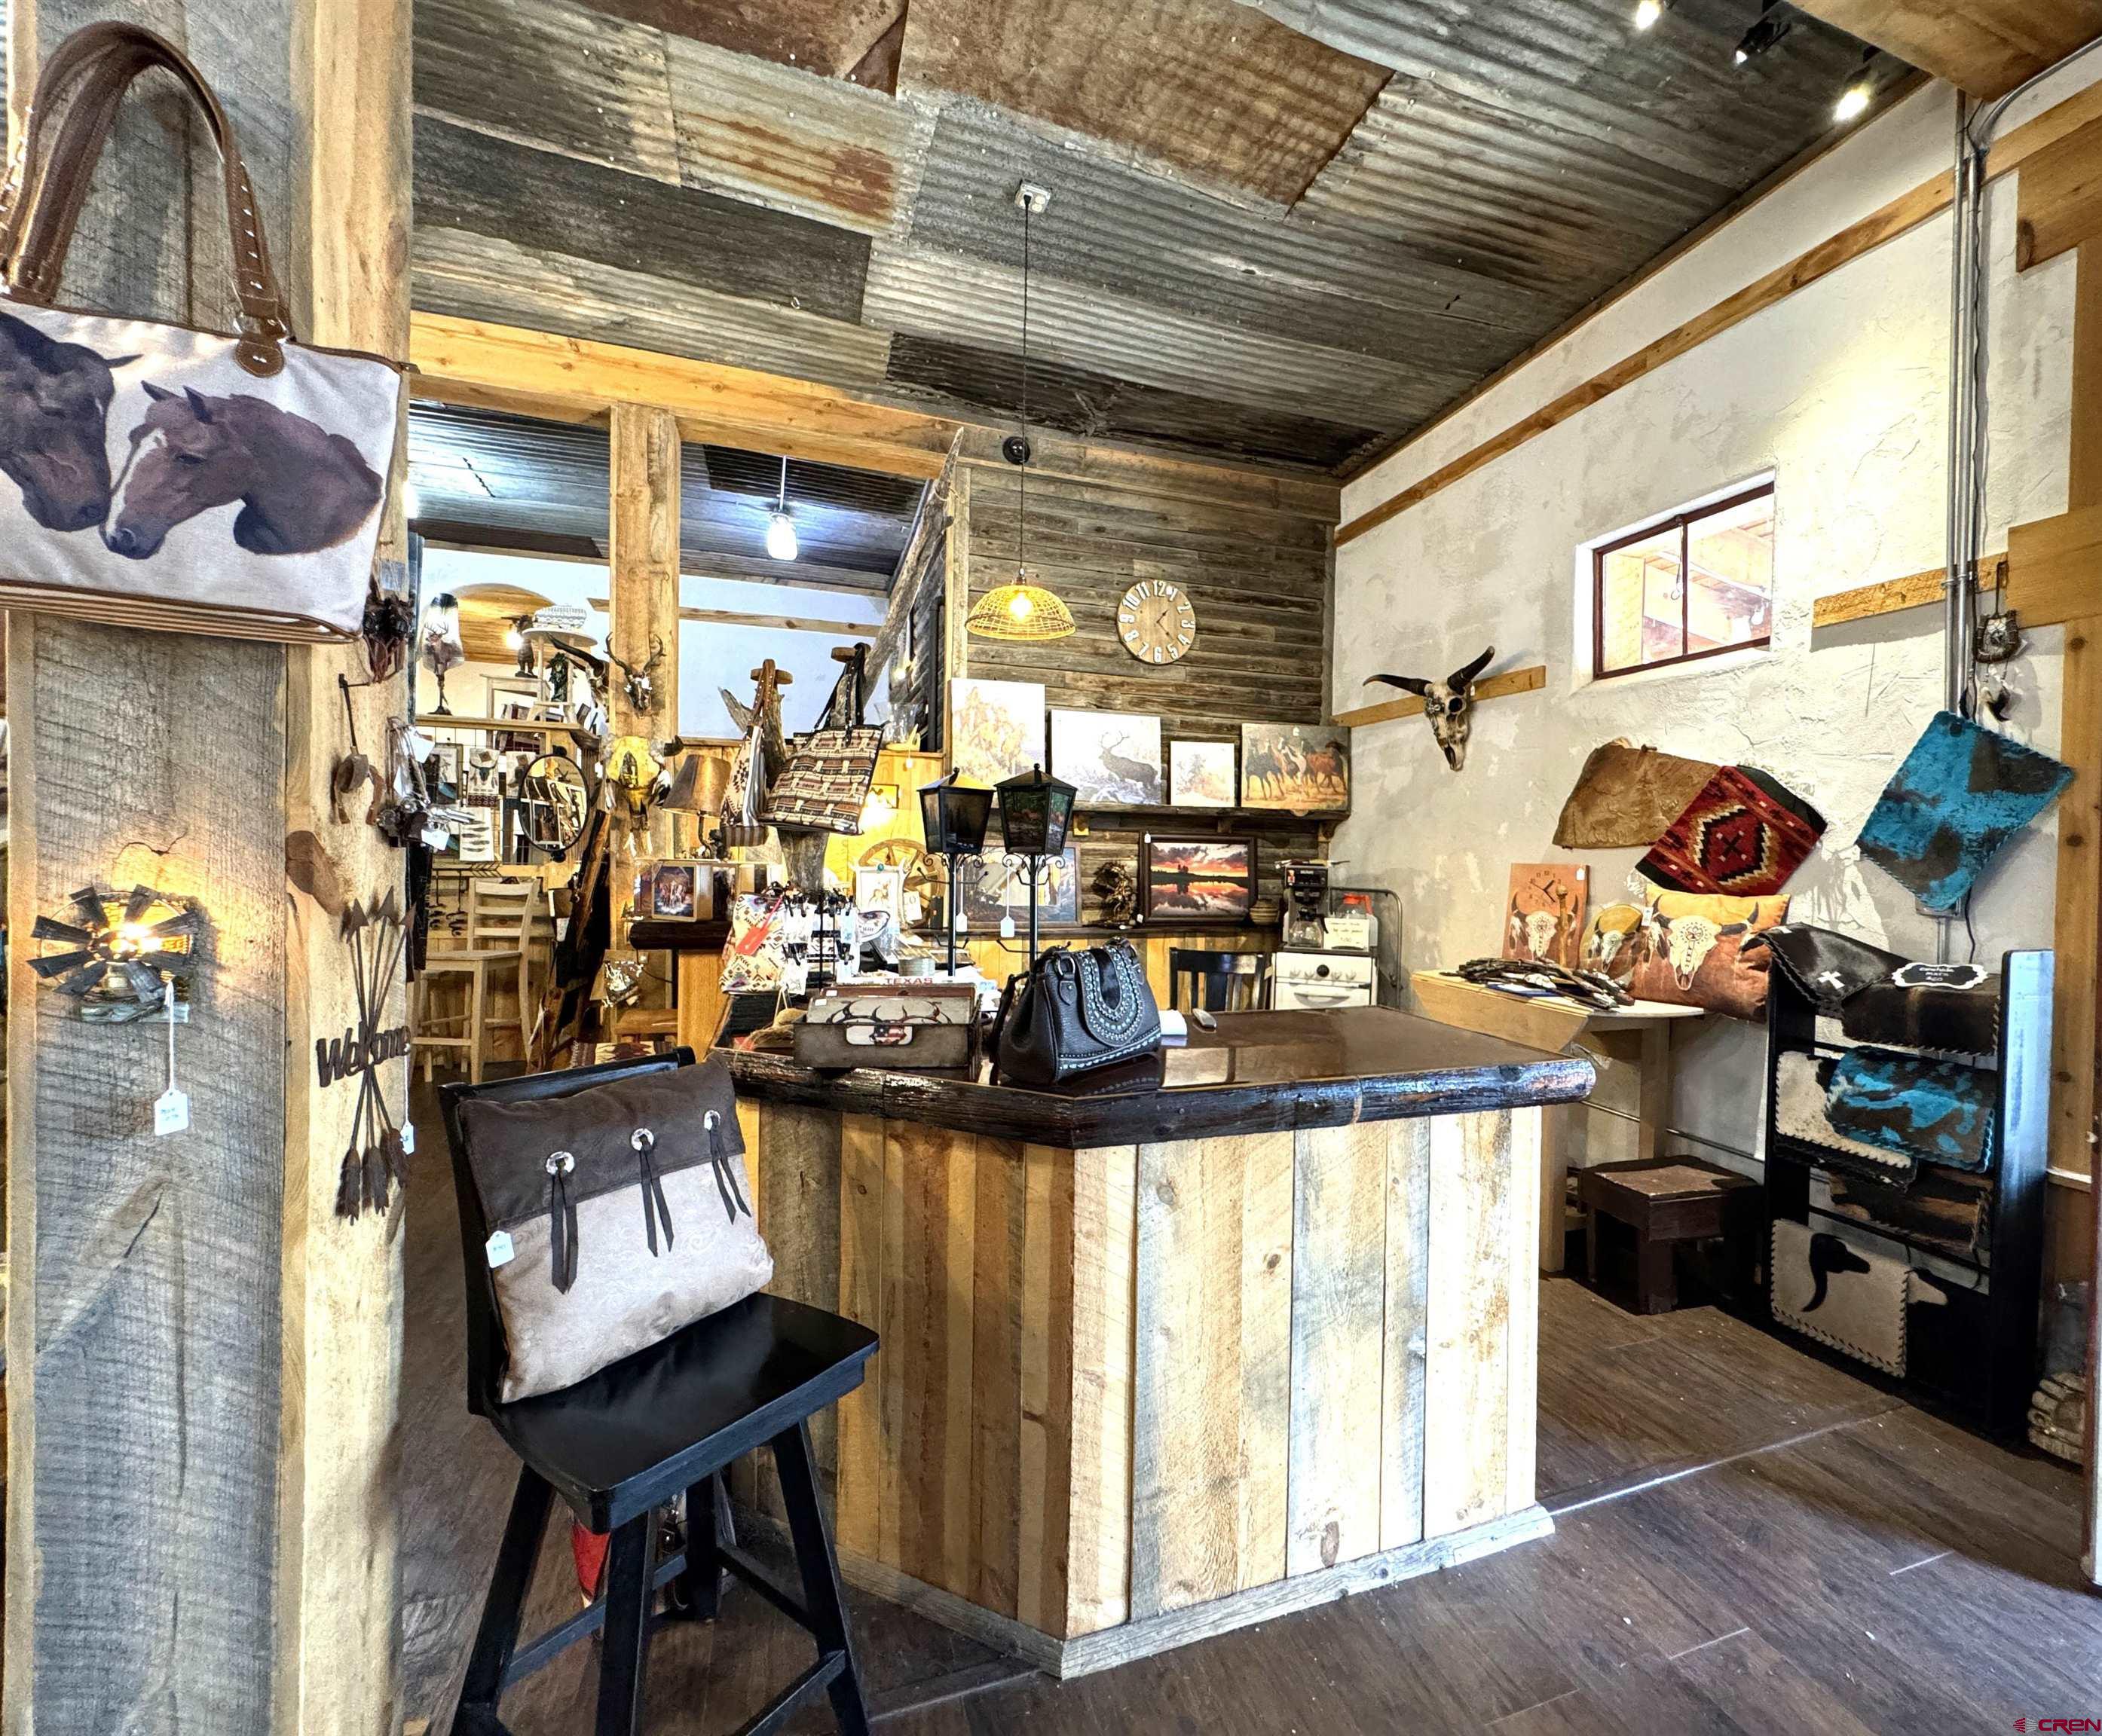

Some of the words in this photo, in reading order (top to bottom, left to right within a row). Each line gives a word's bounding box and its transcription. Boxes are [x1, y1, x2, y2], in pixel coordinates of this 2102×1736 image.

[1135, 581, 1151, 600] 11
[1152, 579, 1166, 597] 12
[1122, 592, 1141, 610] 10
[1176, 601, 1191, 613] 2
[1181, 619, 1196, 628] 3
[1124, 629, 1140, 642] 8
[1177, 634, 1192, 646] 4
[1137, 642, 1149, 658] 7
[1154, 646, 1162, 663] 6
[1167, 643, 1178, 659] 5
